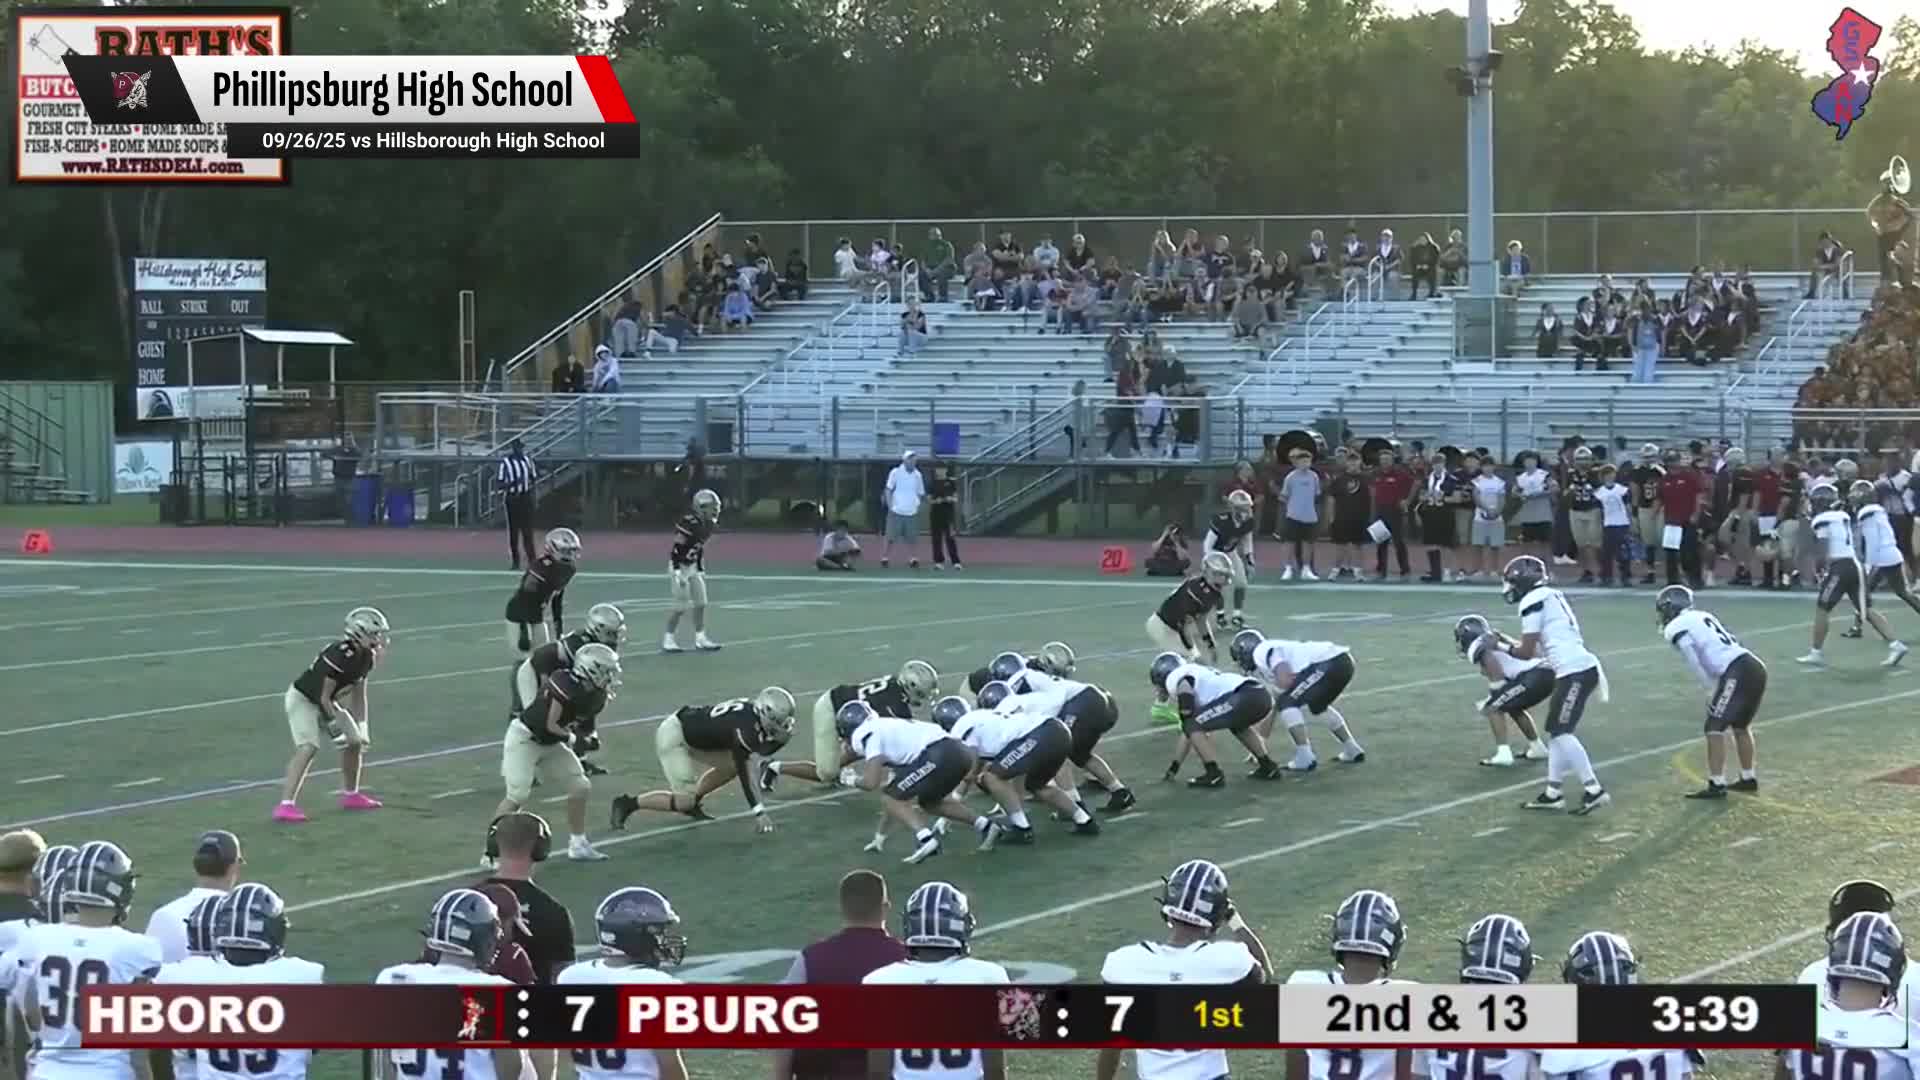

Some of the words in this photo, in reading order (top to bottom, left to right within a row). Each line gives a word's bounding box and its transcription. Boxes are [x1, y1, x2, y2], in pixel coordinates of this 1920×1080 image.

[23, 103, 81, 118] GOURMET
[27, 121, 63, 136] FRESH
[65, 121, 89, 136] CUT
[90, 122, 133, 136] STEAKS
[141, 122, 176, 136] HOME
[179, 122, 212, 136] MADE
[25, 138, 99, 153] FISH-N-CHIPS
[109, 138, 145, 153] HOME
[147, 138, 182, 153] MADE
[183, 138, 220, 153] SOUPS
[230, 300, 250, 313] OUT
[138, 341, 165, 358] GUEST
[138, 368, 165, 385] HOME
[1102, 550, 1123, 568] 20
